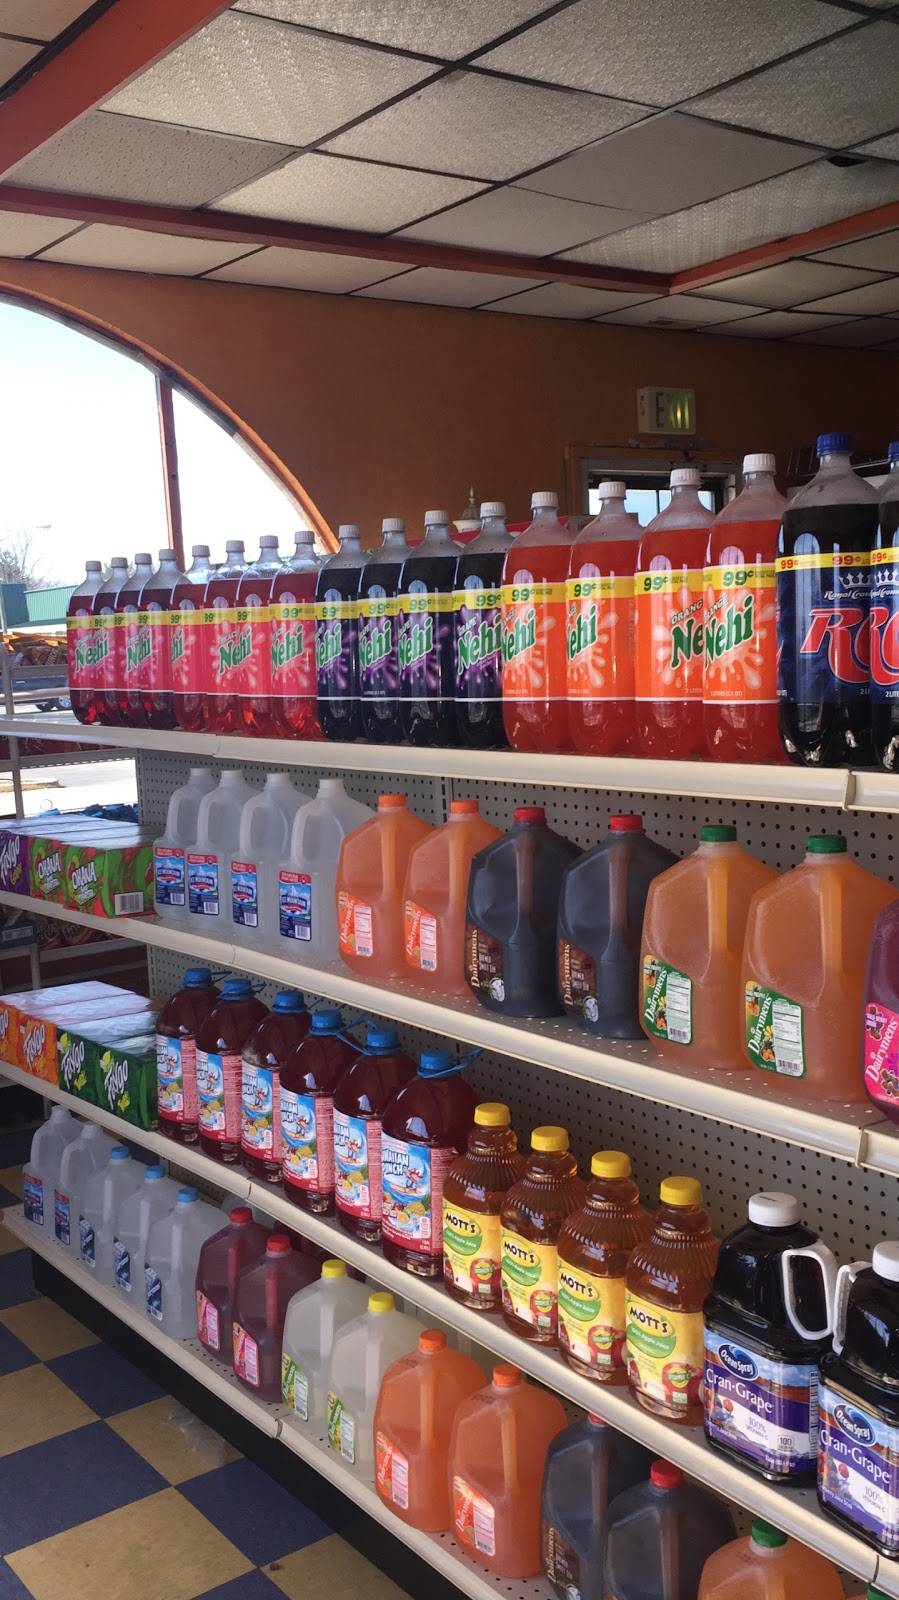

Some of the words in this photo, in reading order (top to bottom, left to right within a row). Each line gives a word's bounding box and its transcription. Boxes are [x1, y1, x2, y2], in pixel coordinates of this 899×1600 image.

[644, 576, 668, 591] 99¢
[723, 570, 753, 586] 99¢
[512, 588, 534, 601] 99¢
[574, 583, 596, 597] 99¢
[824, 591, 850, 601] Royal
[671, 598, 703, 625] ORANG
[61, 1041, 85, 1089] Faygo
[104, 1060, 128, 1110] Faygo
[720, 1349, 738, 1369] Ocean
[737, 1360, 754, 1376] Spray
